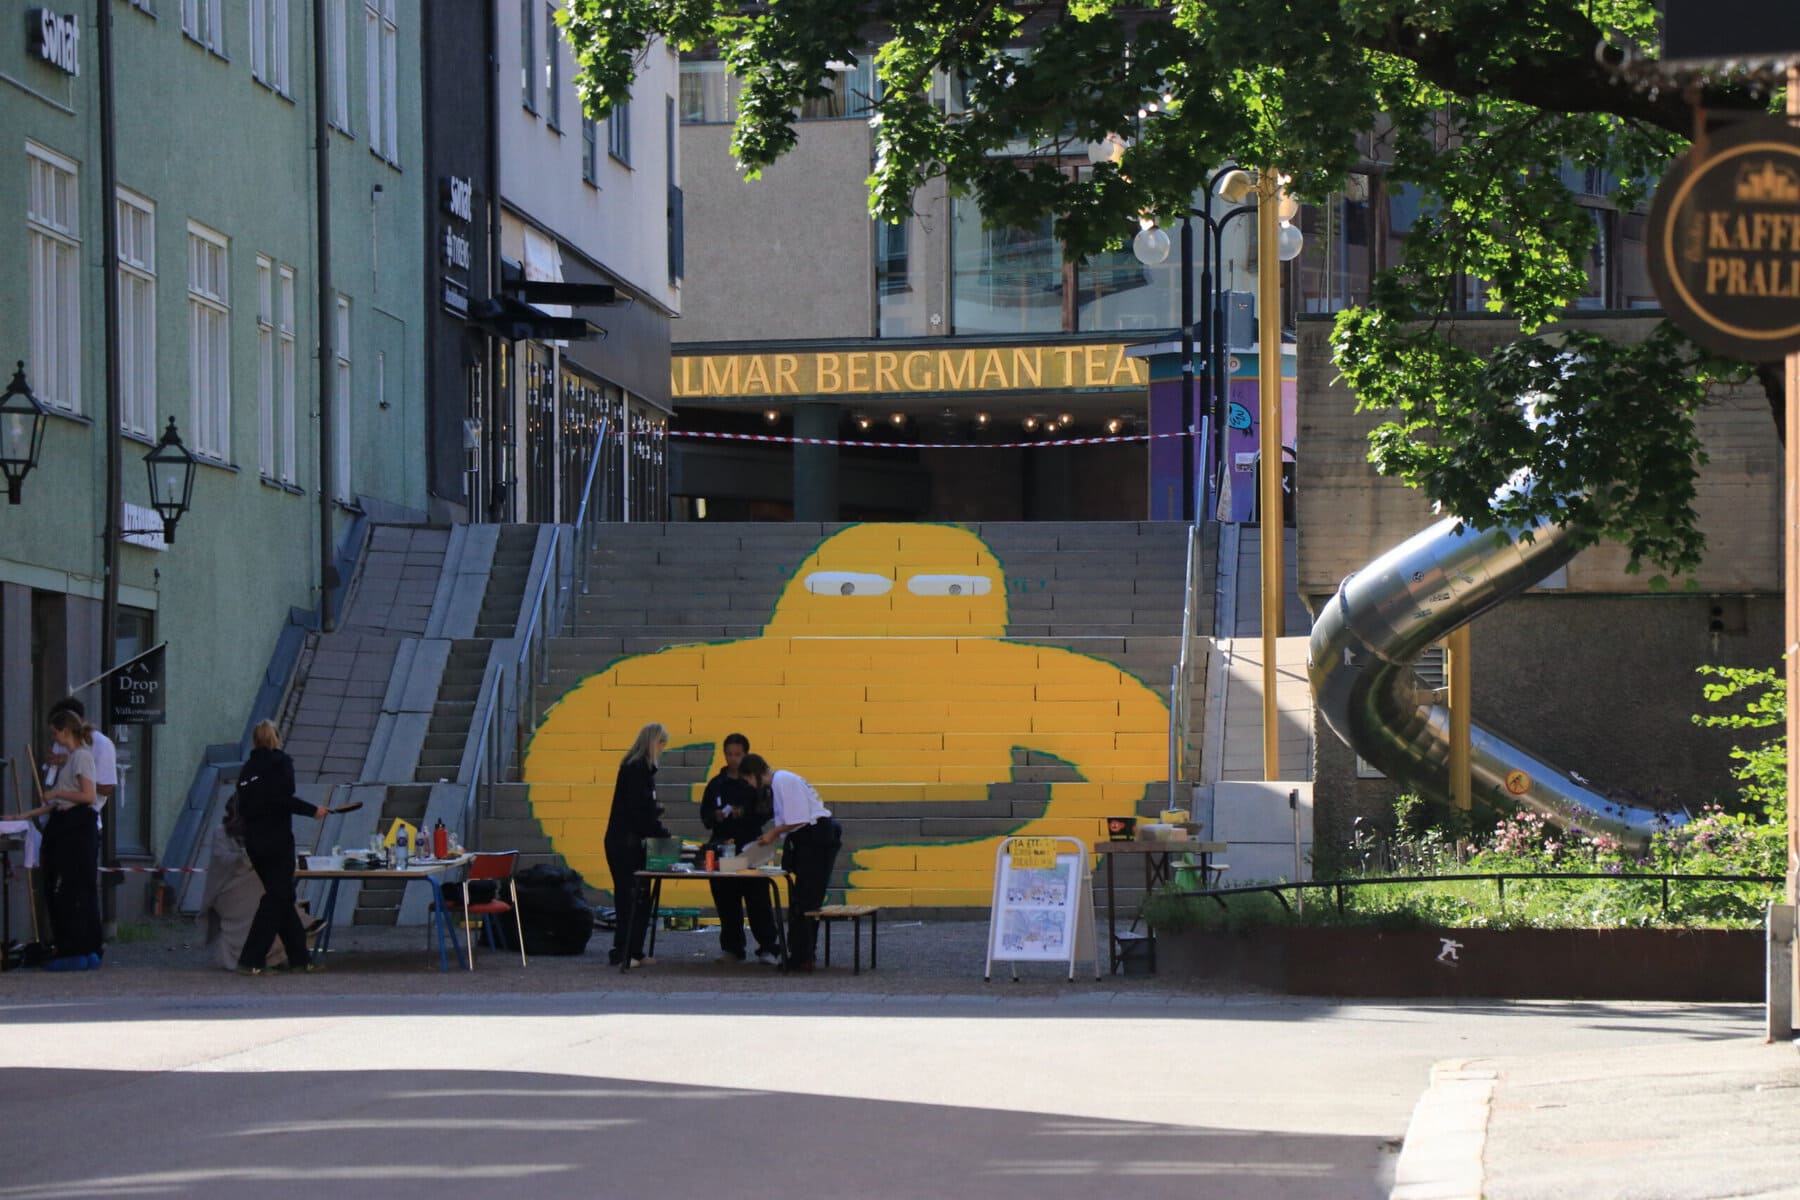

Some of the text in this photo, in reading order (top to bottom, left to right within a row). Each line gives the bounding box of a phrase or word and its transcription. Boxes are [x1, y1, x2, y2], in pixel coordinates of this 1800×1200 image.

[816, 348, 1043, 392] BERGMAN
[1055, 344, 1142, 386] TEA
[120, 676, 158, 693] Drop
[131, 691, 145, 704] in
